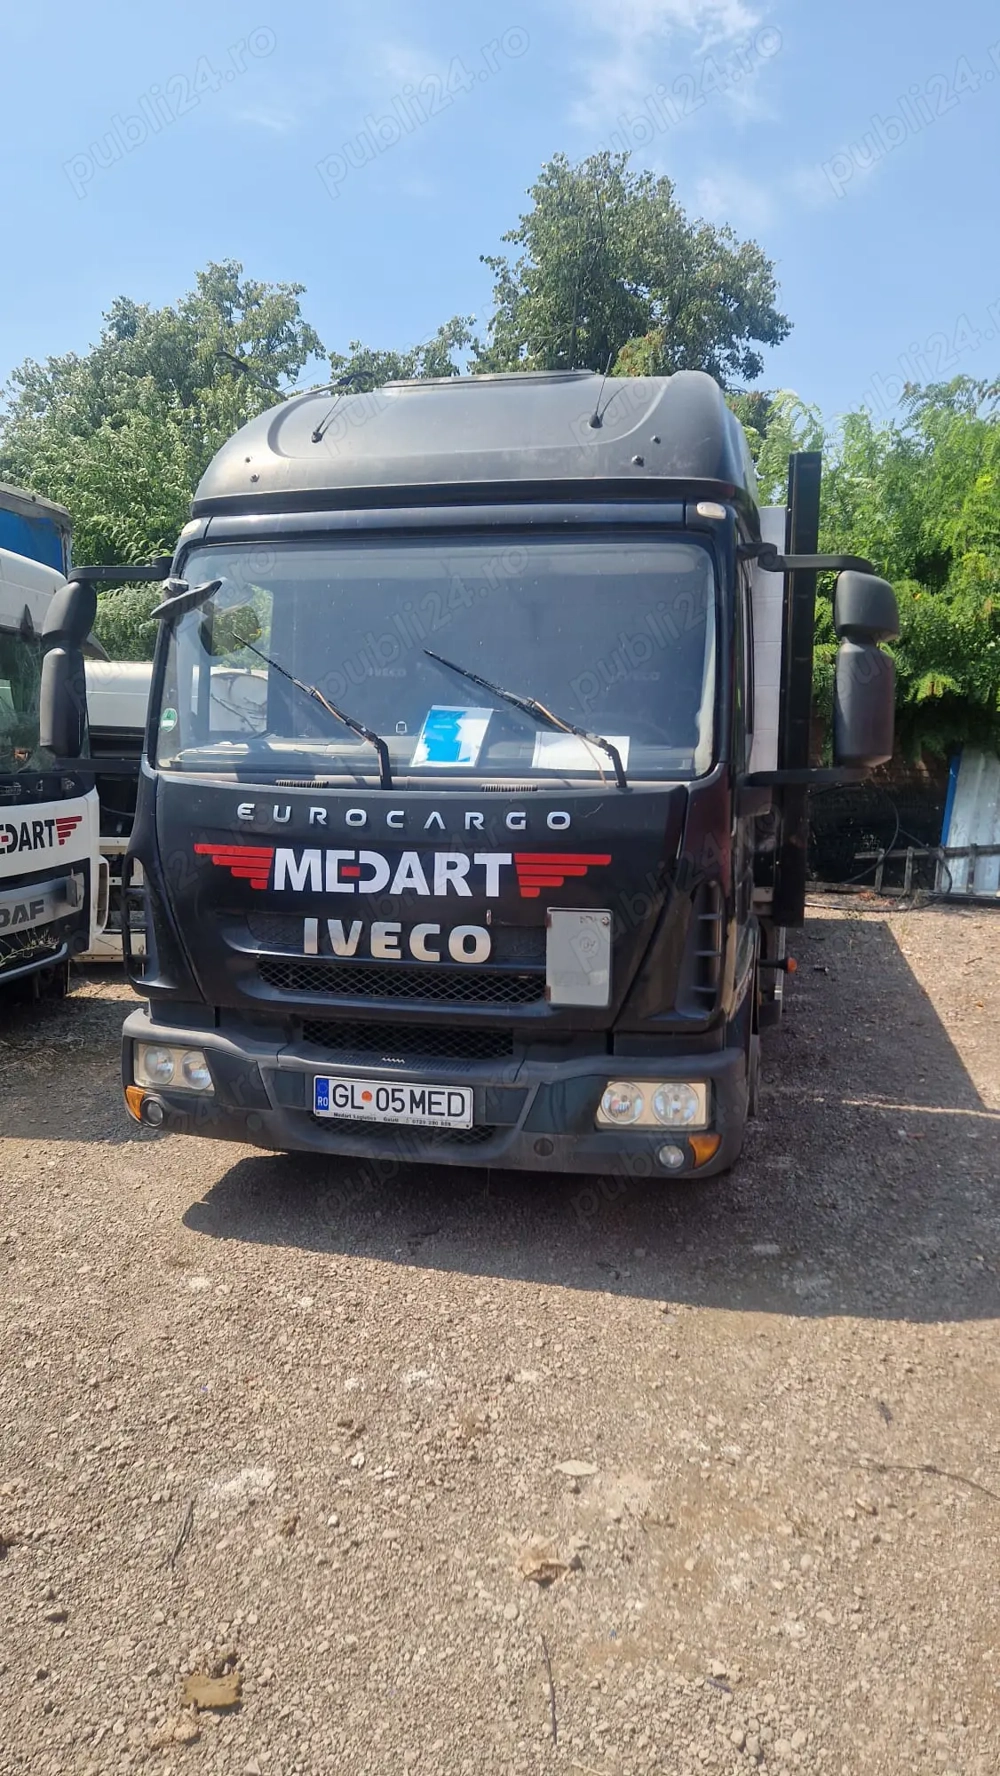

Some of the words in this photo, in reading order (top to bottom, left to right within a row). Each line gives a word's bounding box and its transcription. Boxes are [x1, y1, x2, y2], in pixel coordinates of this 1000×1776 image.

[237, 803, 571, 831] EUROCARGO
[274, 848, 512, 897] MEDART
[303, 917, 491, 963] IVECO
[318, 1096, 329, 1107] RO
[332, 1084, 364, 1110] GL
